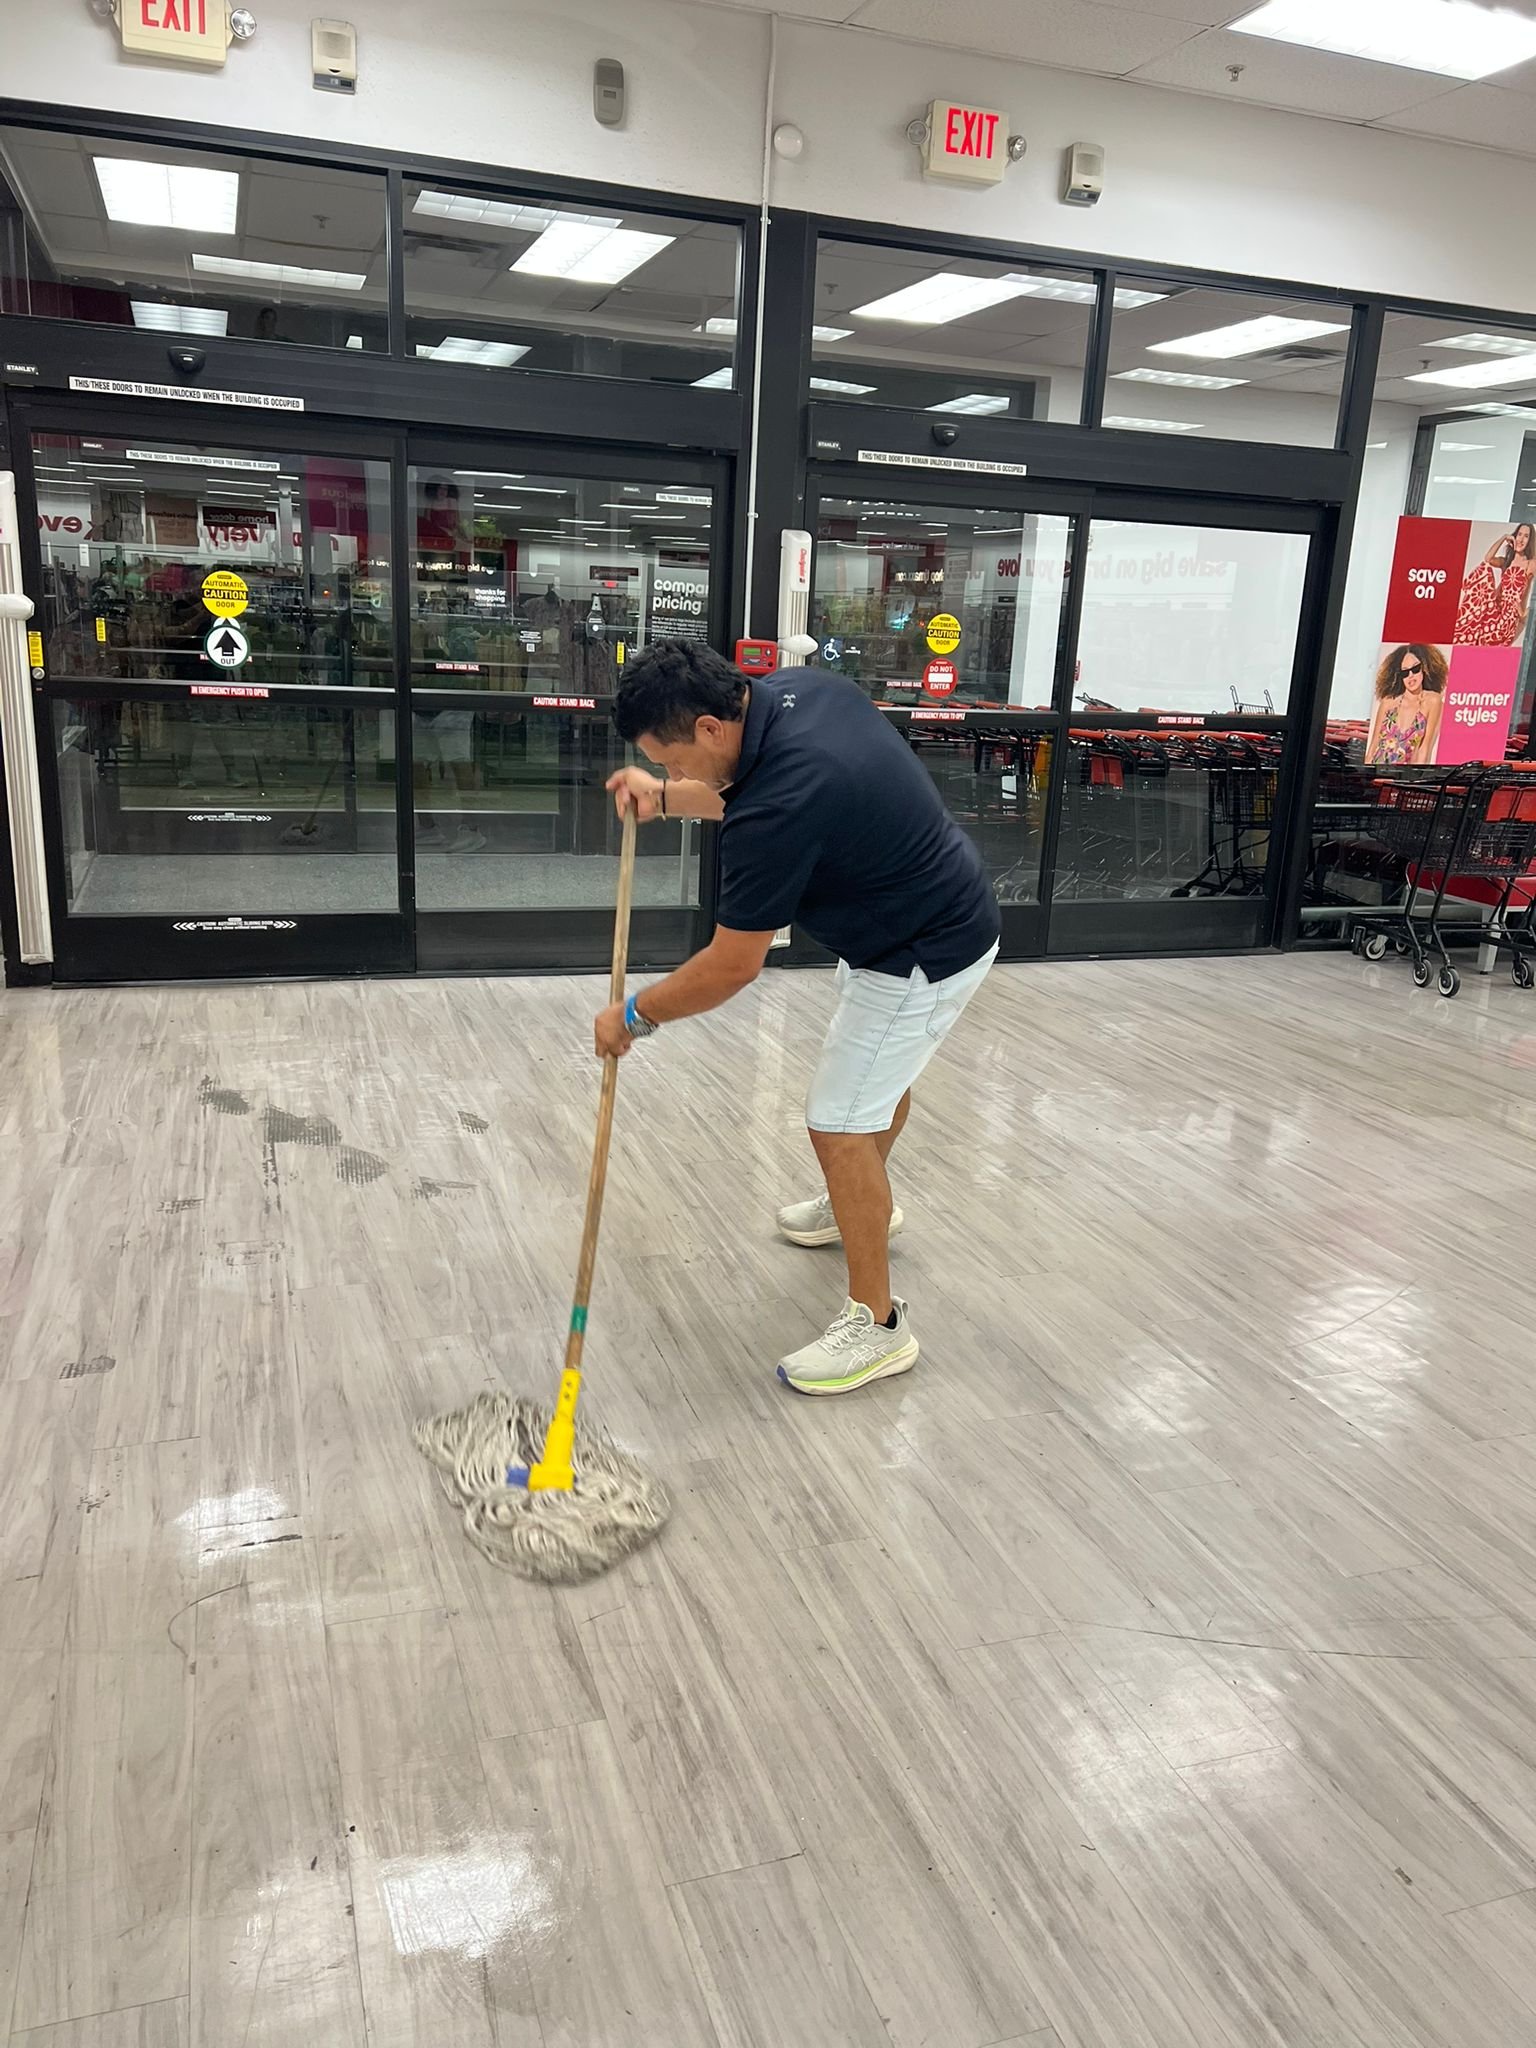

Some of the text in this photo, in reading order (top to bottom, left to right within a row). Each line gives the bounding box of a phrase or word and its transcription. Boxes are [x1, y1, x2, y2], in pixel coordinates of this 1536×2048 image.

[946, 108, 999, 159] EXIT
[6, 364, 36, 373] STANLEY
[112, 383, 133, 393] DOORS
[134, 384, 143, 393] TO
[144, 386, 168, 396] REMAIN
[170, 388, 201, 399] UNLOCKED
[203, 392, 220, 401] WHEN
[222, 393, 233, 402] THE
[235, 394, 262, 405] BUILDING
[264, 397, 270, 406] IS
[271, 398, 301, 409] OCCUPIED
[817, 441, 840, 449] STANLEY
[888, 454, 904, 463] DOORS
[904, 455, 910, 463] TO
[912, 456, 929, 465] REMAIN
[930, 458, 951, 467] UNLOCKED
[952, 460, 967, 468] WHEN
[967, 460, 975, 469] THE
[976, 462, 996, 471] BUILDING
[997, 463, 1001, 471] IS
[1002, 464, 1024, 474] OCCUPIED
[1408, 568, 1446, 583] save
[205, 580, 244, 588] AUTOMATIC
[204, 589, 247, 600] CAUTION
[1414, 585, 1436, 599] on
[652, 595, 702, 615] pricing
[928, 630, 959, 638] CAUTION
[436, 662, 453, 670] CAUTION
[468, 664, 480, 672] BACK
[198, 686, 231, 696] EMERGENCY
[231, 687, 245, 696] PUSH
[246, 688, 253, 696] TO
[254, 688, 268, 698] OPEN
[533, 697, 595, 708] CAUTION STAND BACK
[1450, 692, 1510, 706] summer
[1455, 707, 1498, 727] styles
